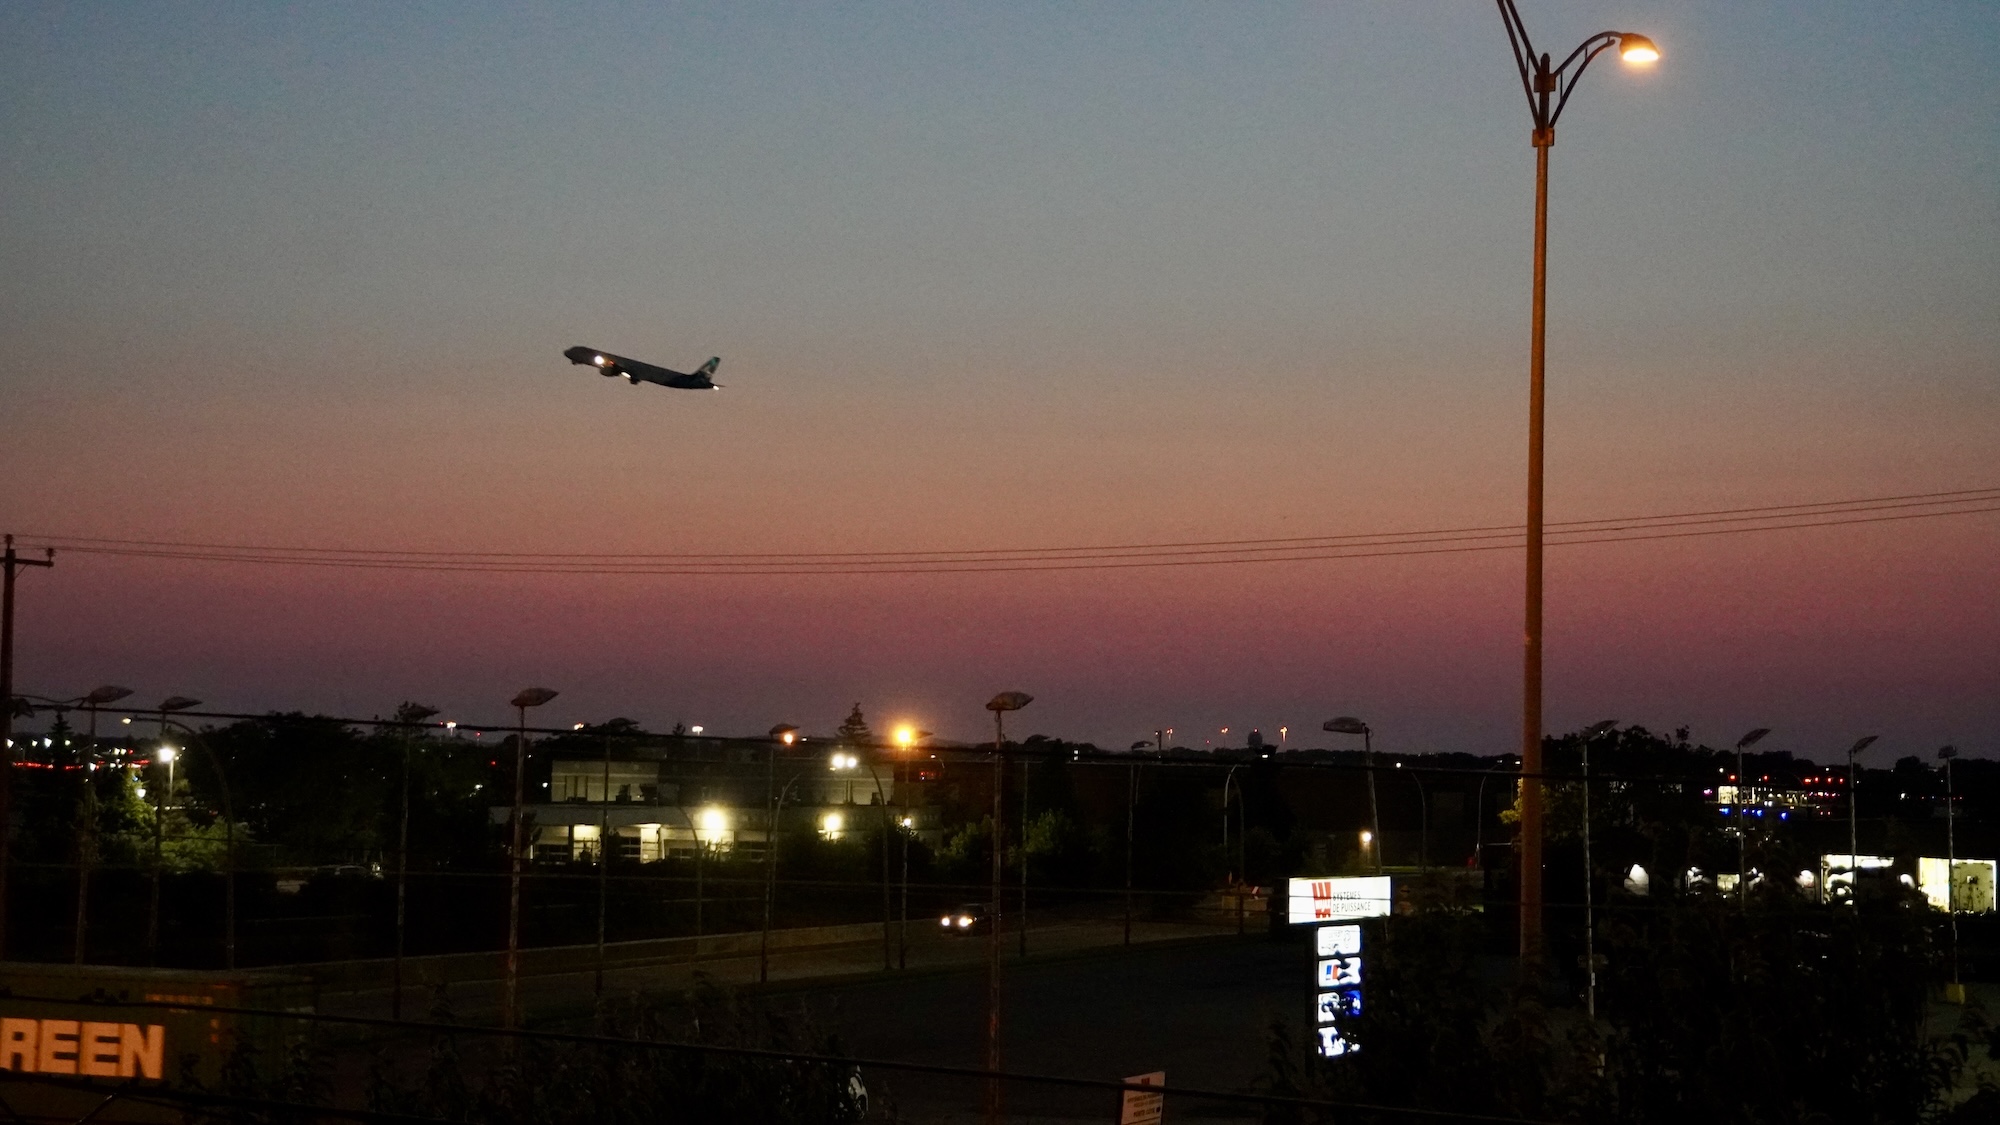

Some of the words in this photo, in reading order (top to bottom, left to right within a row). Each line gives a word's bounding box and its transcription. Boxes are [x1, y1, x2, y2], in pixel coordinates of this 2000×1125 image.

[1332, 903, 1340, 913] DE
[1341, 901, 1371, 912] PUISSANCE
[0, 1017, 165, 1079] REEN
